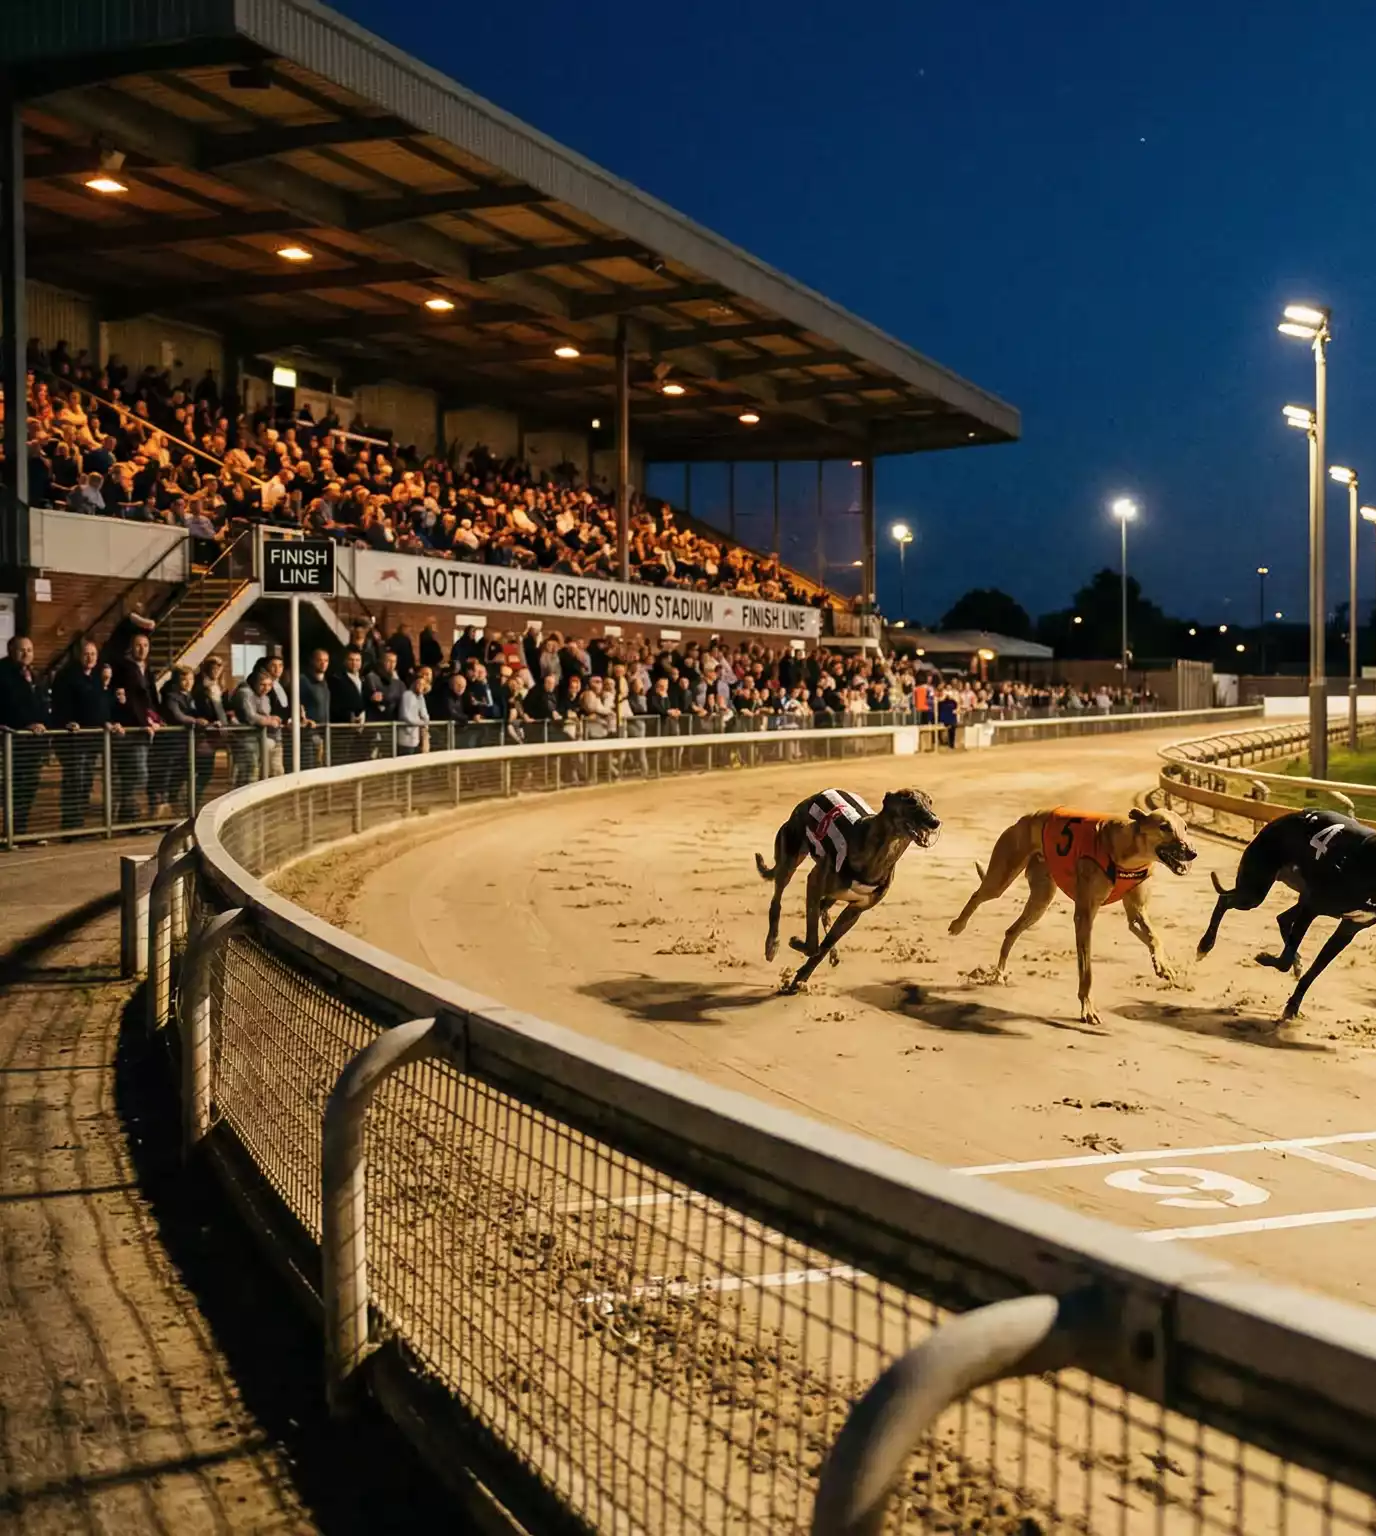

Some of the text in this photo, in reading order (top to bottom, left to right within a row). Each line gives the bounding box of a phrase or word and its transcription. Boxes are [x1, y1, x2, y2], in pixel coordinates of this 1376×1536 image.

[270, 549, 328, 566] FINISH
[279, 568, 319, 585] LINE
[417, 566, 714, 624] NOTTINGHAM GREYHOUND STADIUM
[742, 605, 806, 631] FINISH LINE
[1056, 817, 1082, 856] 5
[1310, 823, 1345, 860] 4
